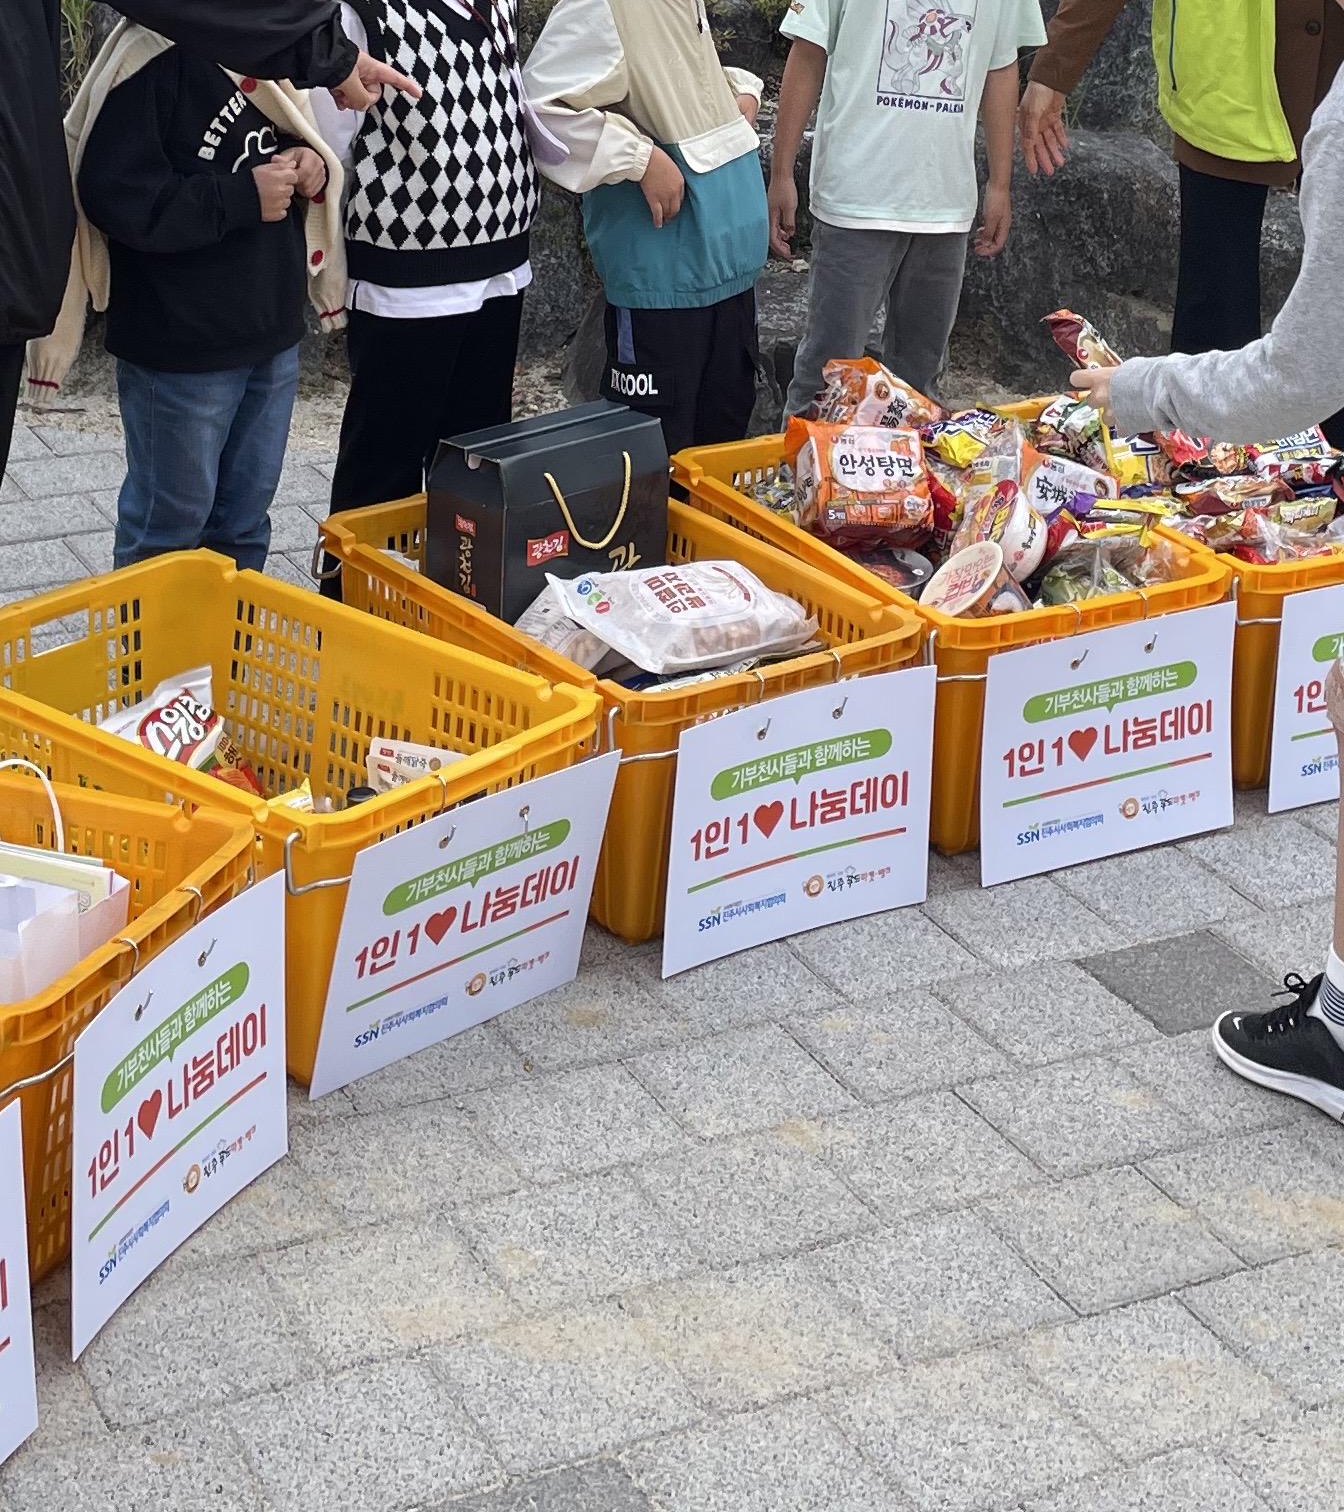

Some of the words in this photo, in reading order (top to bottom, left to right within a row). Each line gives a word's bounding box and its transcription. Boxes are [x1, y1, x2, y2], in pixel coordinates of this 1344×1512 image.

[197, 90, 247, 161] BETTER
[839, 453, 915, 478] 안성탕면
[1044, 682, 1125, 716] 기부천사들과
[1126, 668, 1179, 697] 함께하는
[731, 748, 813, 790] 기부천사들과
[814, 737, 872, 768] 함께하는
[1003, 739, 1045, 778] 1인
[1103, 699, 1213, 756] 나눔데이
[1301, 762, 1322, 777] SSN
[690, 816, 731, 862] 1인
[790, 770, 910, 831] 나눔데이
[1017, 830, 1040, 846] SSN
[406, 850, 492, 903] 기부천사들과
[494, 829, 551, 869] 함께하는
[354, 929, 401, 980] 1인
[460, 855, 581, 934] 나눔데이
[698, 912, 722, 932] SSN
[116, 1021, 183, 1091] 기부천사들과
[183, 980, 232, 1030] 함께하는
[354, 1026, 380, 1048] SSN
[88, 1128, 121, 1199] 1인
[167, 1003, 267, 1121] 나눔데이
[99, 1253, 117, 1286] SSN
